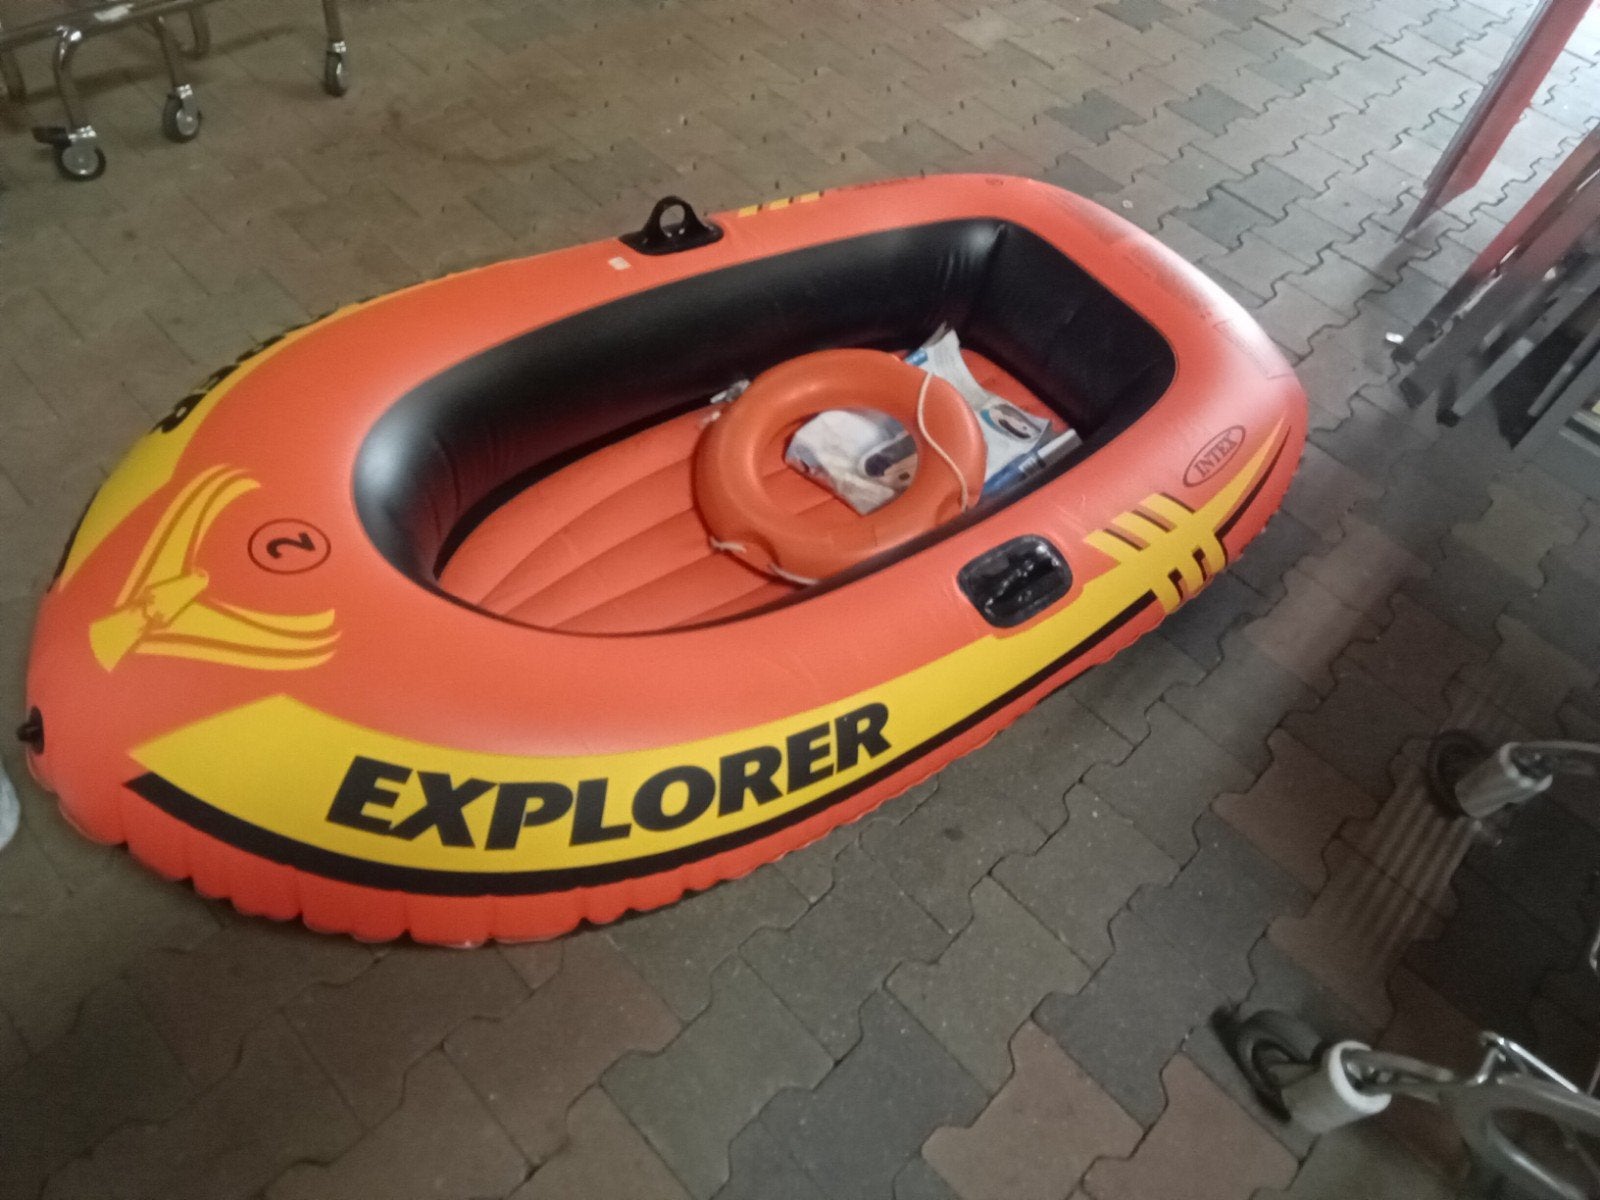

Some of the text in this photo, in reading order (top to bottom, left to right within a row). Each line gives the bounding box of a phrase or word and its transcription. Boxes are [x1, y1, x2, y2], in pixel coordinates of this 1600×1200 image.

[1193, 430, 1238, 478] INTEX
[266, 532, 316, 559] 2
[325, 702, 892, 851] EXPLORER
